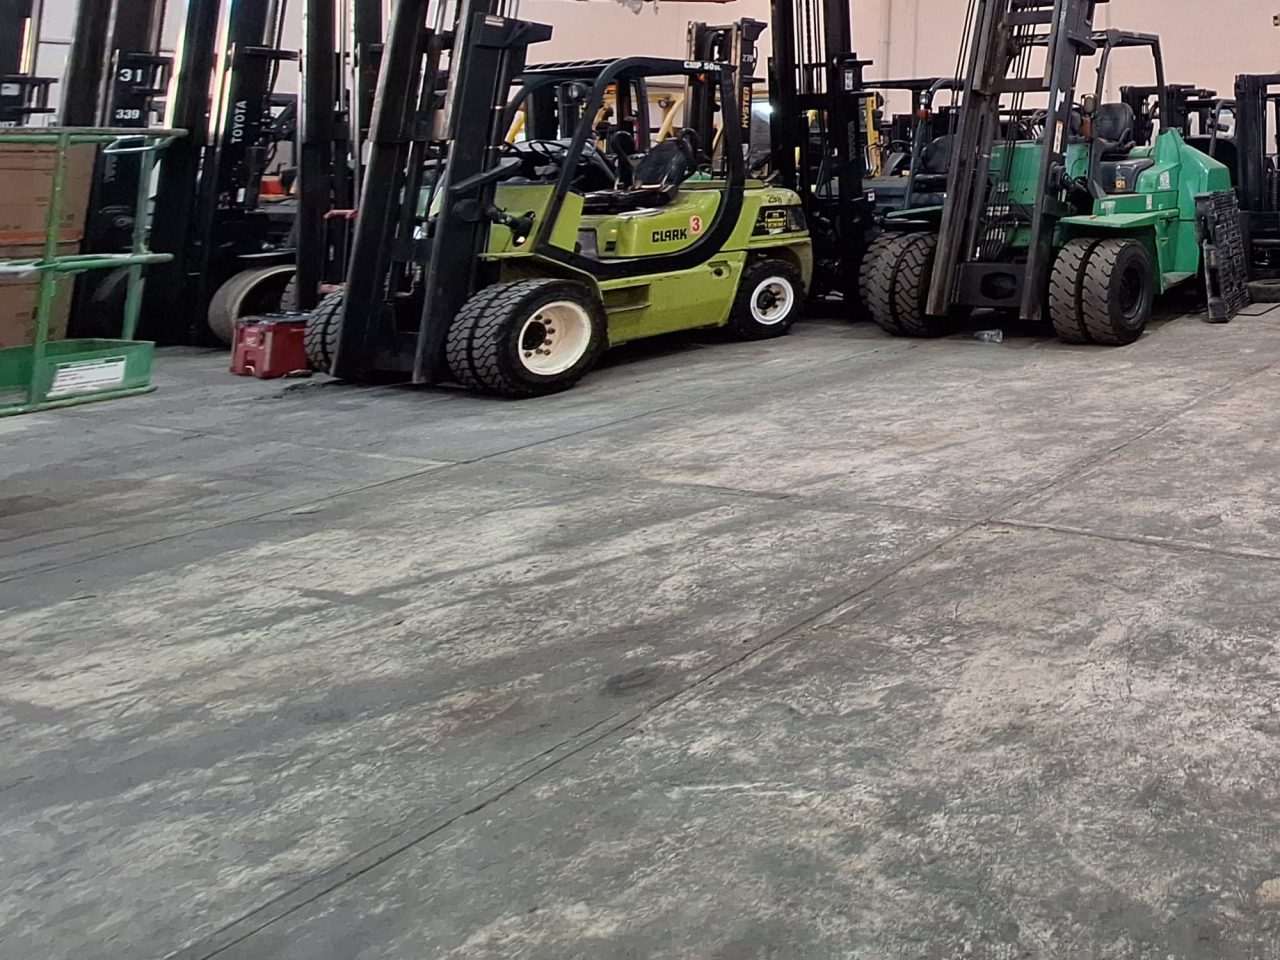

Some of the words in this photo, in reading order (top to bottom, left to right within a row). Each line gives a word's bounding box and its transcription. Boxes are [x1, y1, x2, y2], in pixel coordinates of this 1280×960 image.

[120, 69, 143, 82] 31
[115, 109, 140, 119] 339
[741, 86, 751, 128] HYSTER
[231, 101, 247, 144] TOYOTA
[692, 217, 700, 232] 3
[652, 228, 687, 242] CLARK
